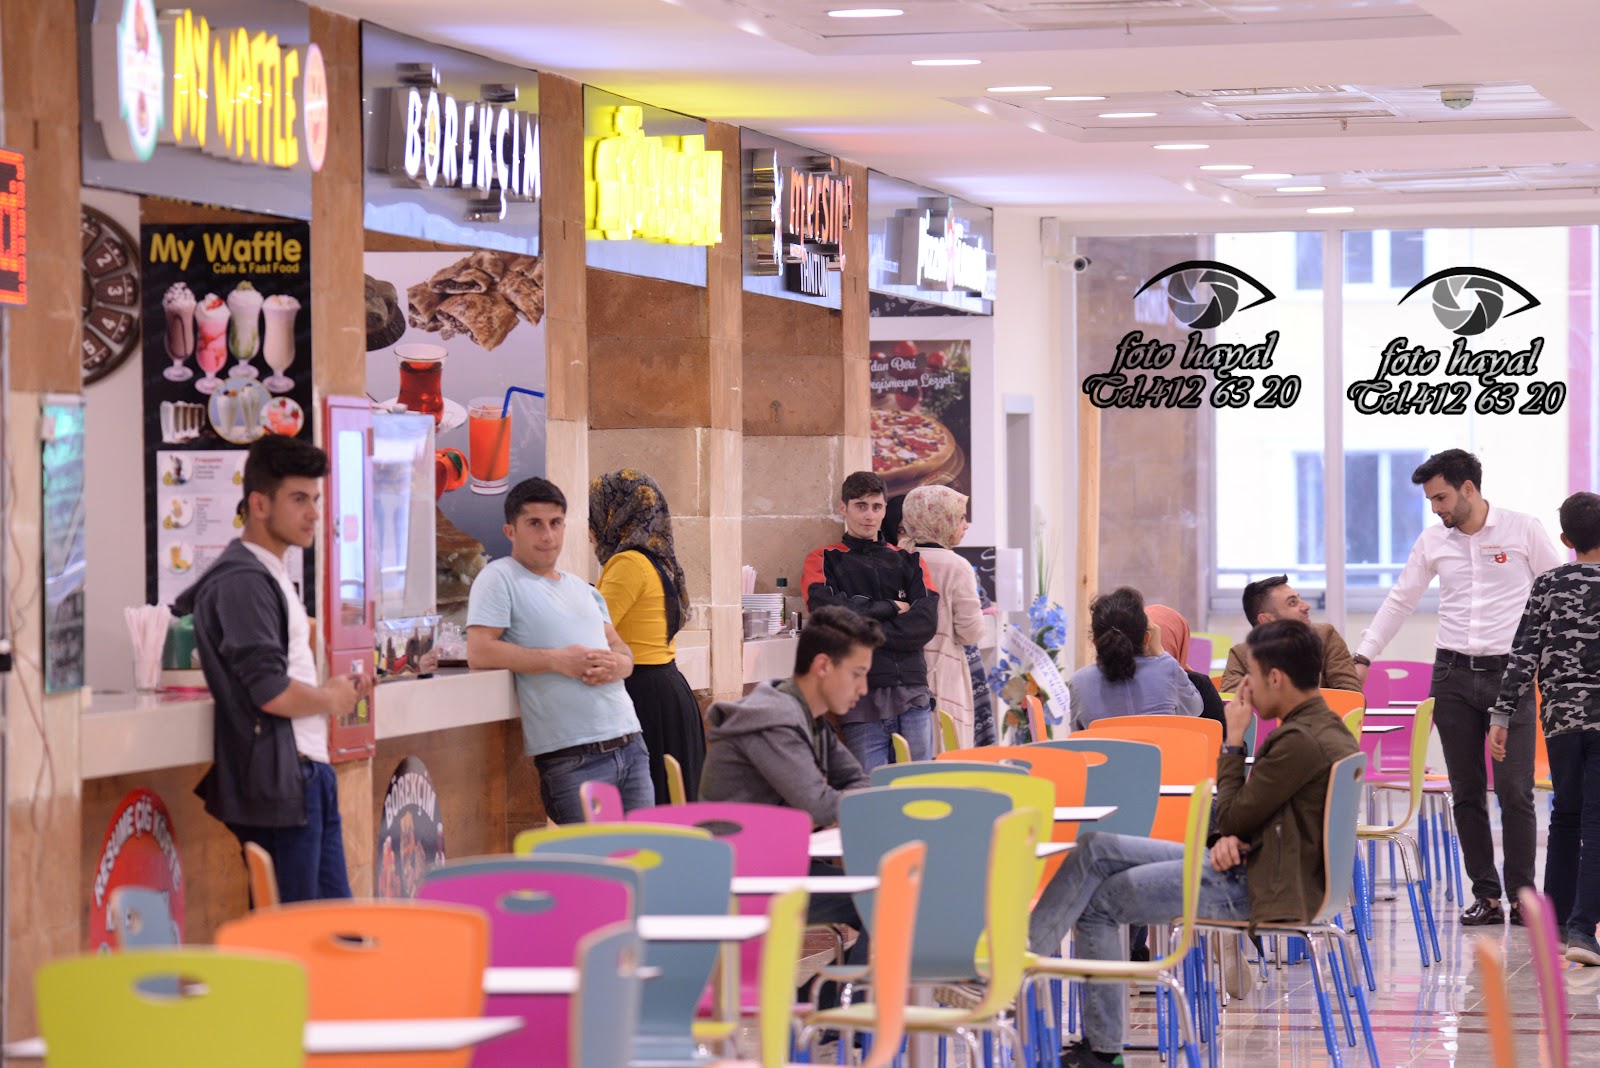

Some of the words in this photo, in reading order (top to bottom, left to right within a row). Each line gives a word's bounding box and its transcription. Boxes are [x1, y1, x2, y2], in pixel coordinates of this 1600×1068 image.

[173, 8, 209, 147] MY
[213, 27, 299, 168] WAFFLE
[149, 232, 194, 271] My
[203, 231, 302, 262] Waffle
[96, 252, 112, 268] 2
[212, 262, 236, 274] Cafe
[238, 262, 247, 274] &
[249, 262, 272, 274] Fast
[272, 262, 299, 274] Food
[107, 285, 123, 297] 3
[101, 317, 117, 331] 4
